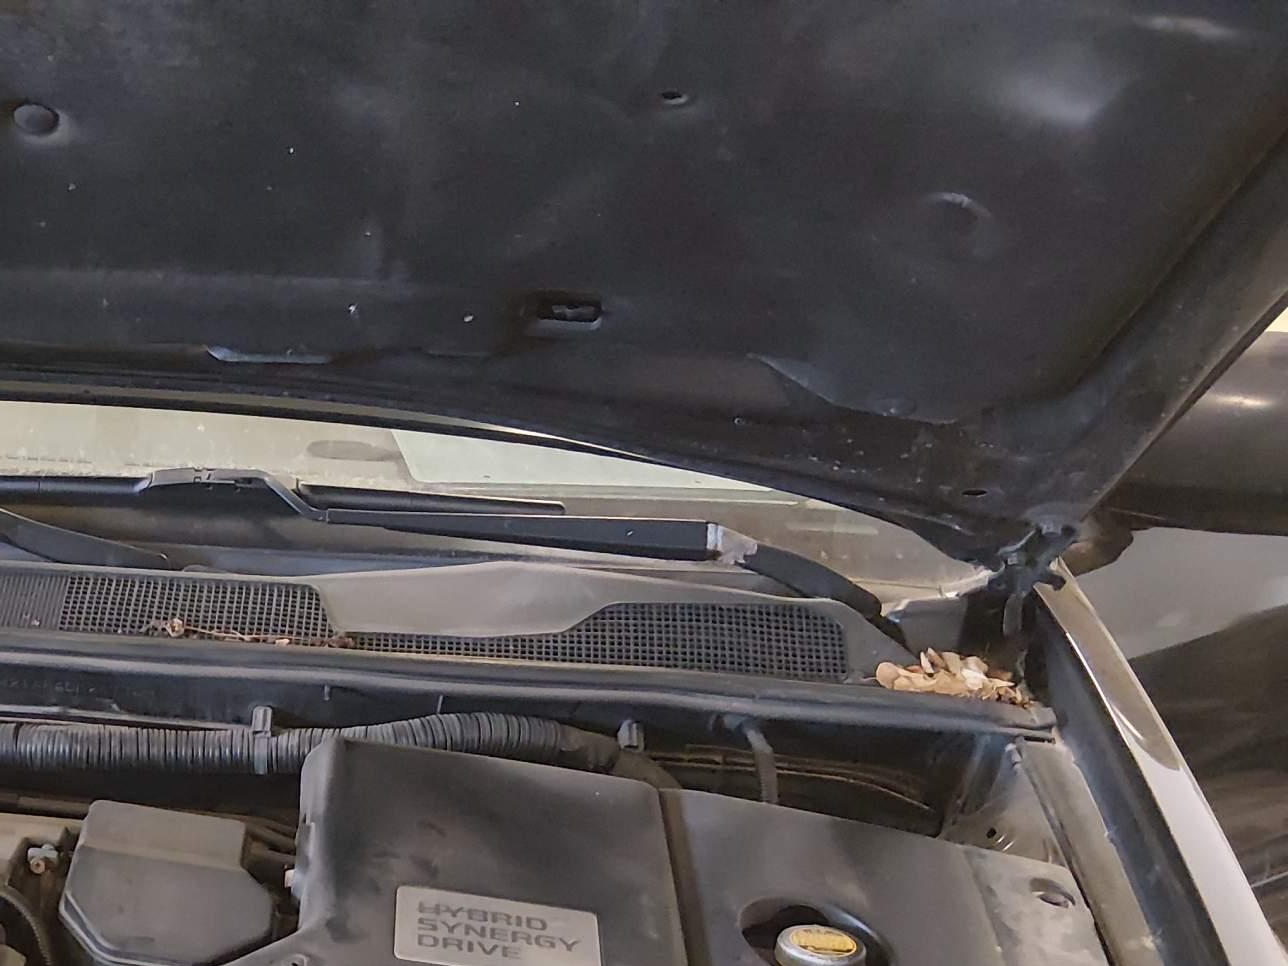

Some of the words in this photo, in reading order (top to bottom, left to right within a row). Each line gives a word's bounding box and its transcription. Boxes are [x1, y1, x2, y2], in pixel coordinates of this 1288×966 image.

[417, 901, 548, 931] HYBRID
[417, 917, 581, 952] SYNERGY
[417, 934, 522, 959] DRIVE
